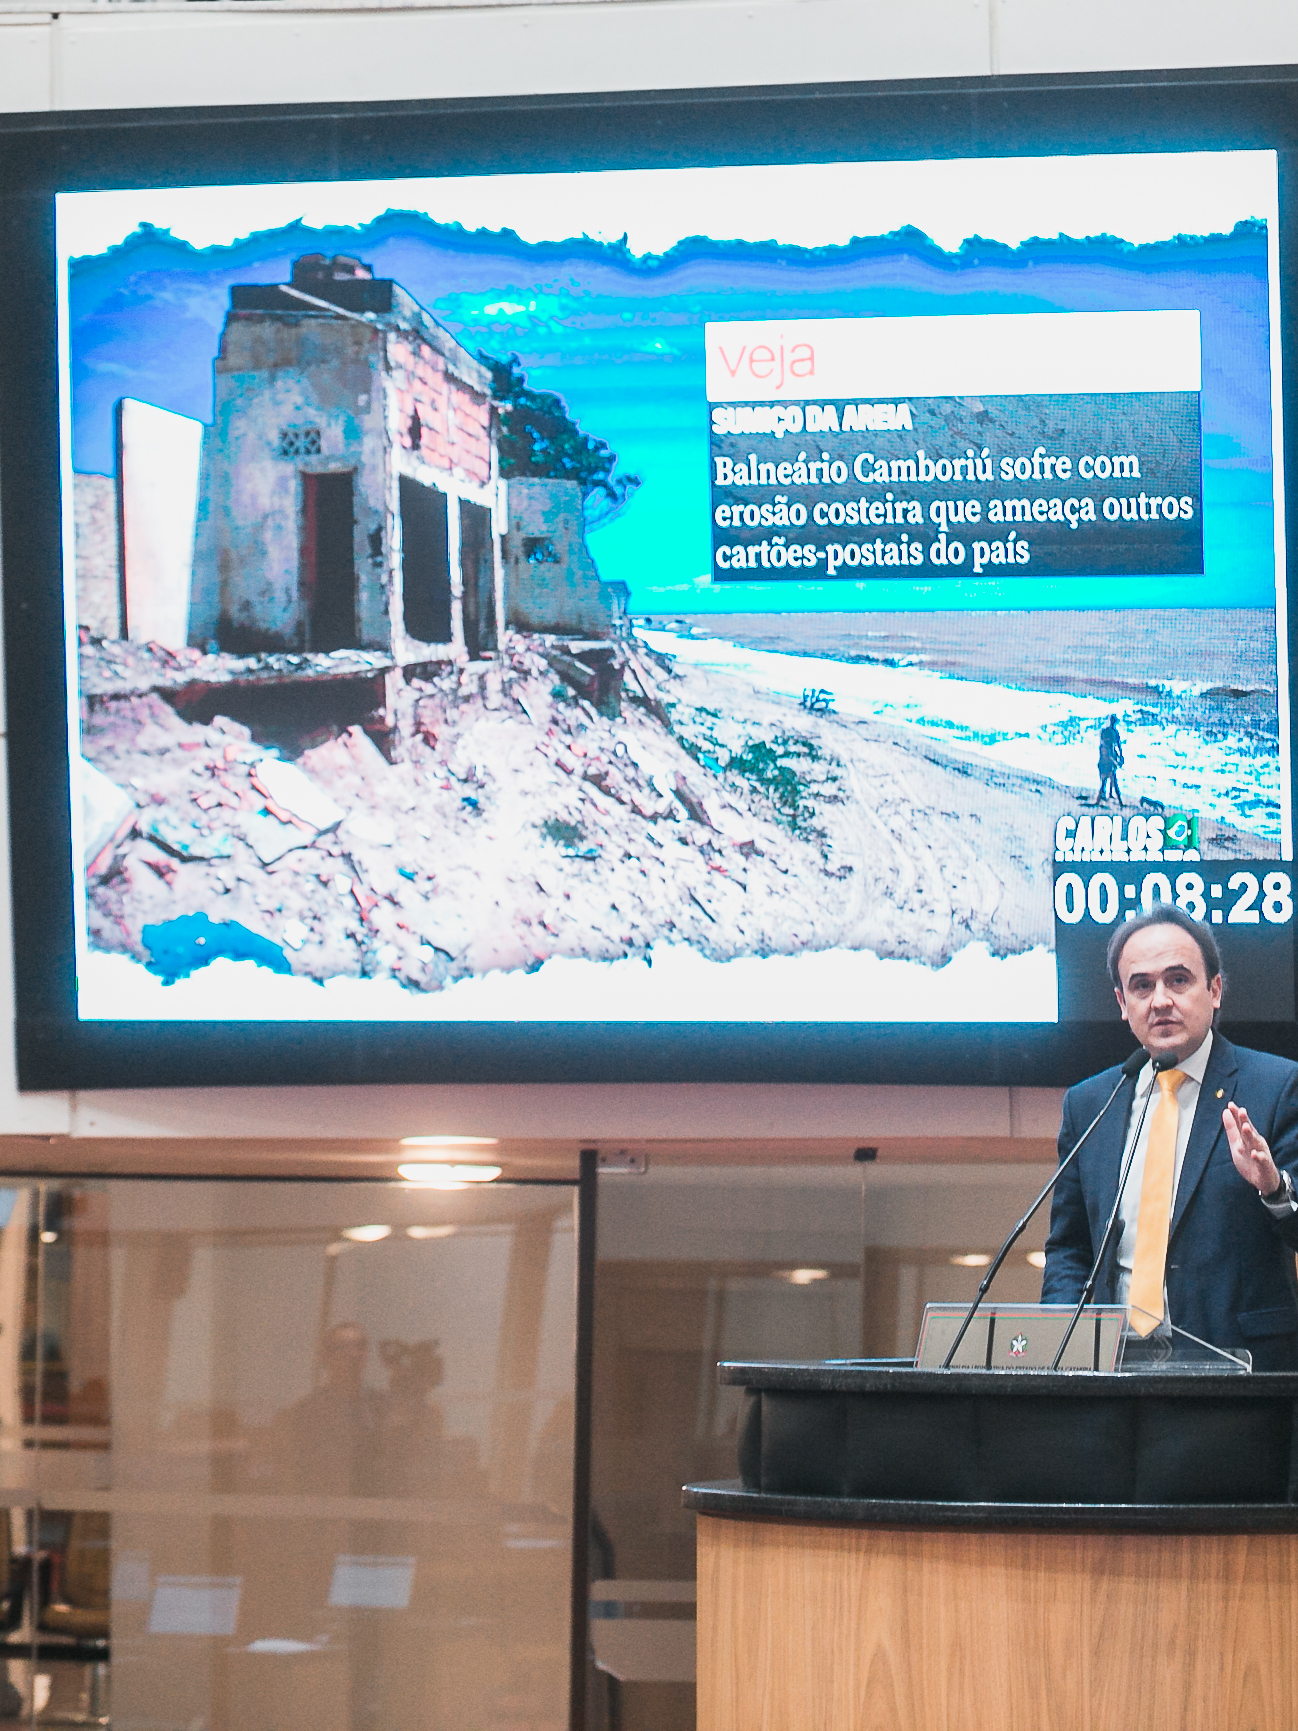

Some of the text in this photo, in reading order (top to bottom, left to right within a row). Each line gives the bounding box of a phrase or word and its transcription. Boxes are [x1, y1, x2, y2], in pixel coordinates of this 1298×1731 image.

[718, 334, 815, 390] veja
[805, 405, 840, 432] DA
[842, 403, 913, 431] AREIA
[714, 446, 1141, 486] Balneário Camboriú sofre com
[714, 491, 1193, 532] erosão costeira que ameaça outros
[715, 530, 1030, 576] cartões-postais do país
[1055, 815, 1165, 851] CARLOS
